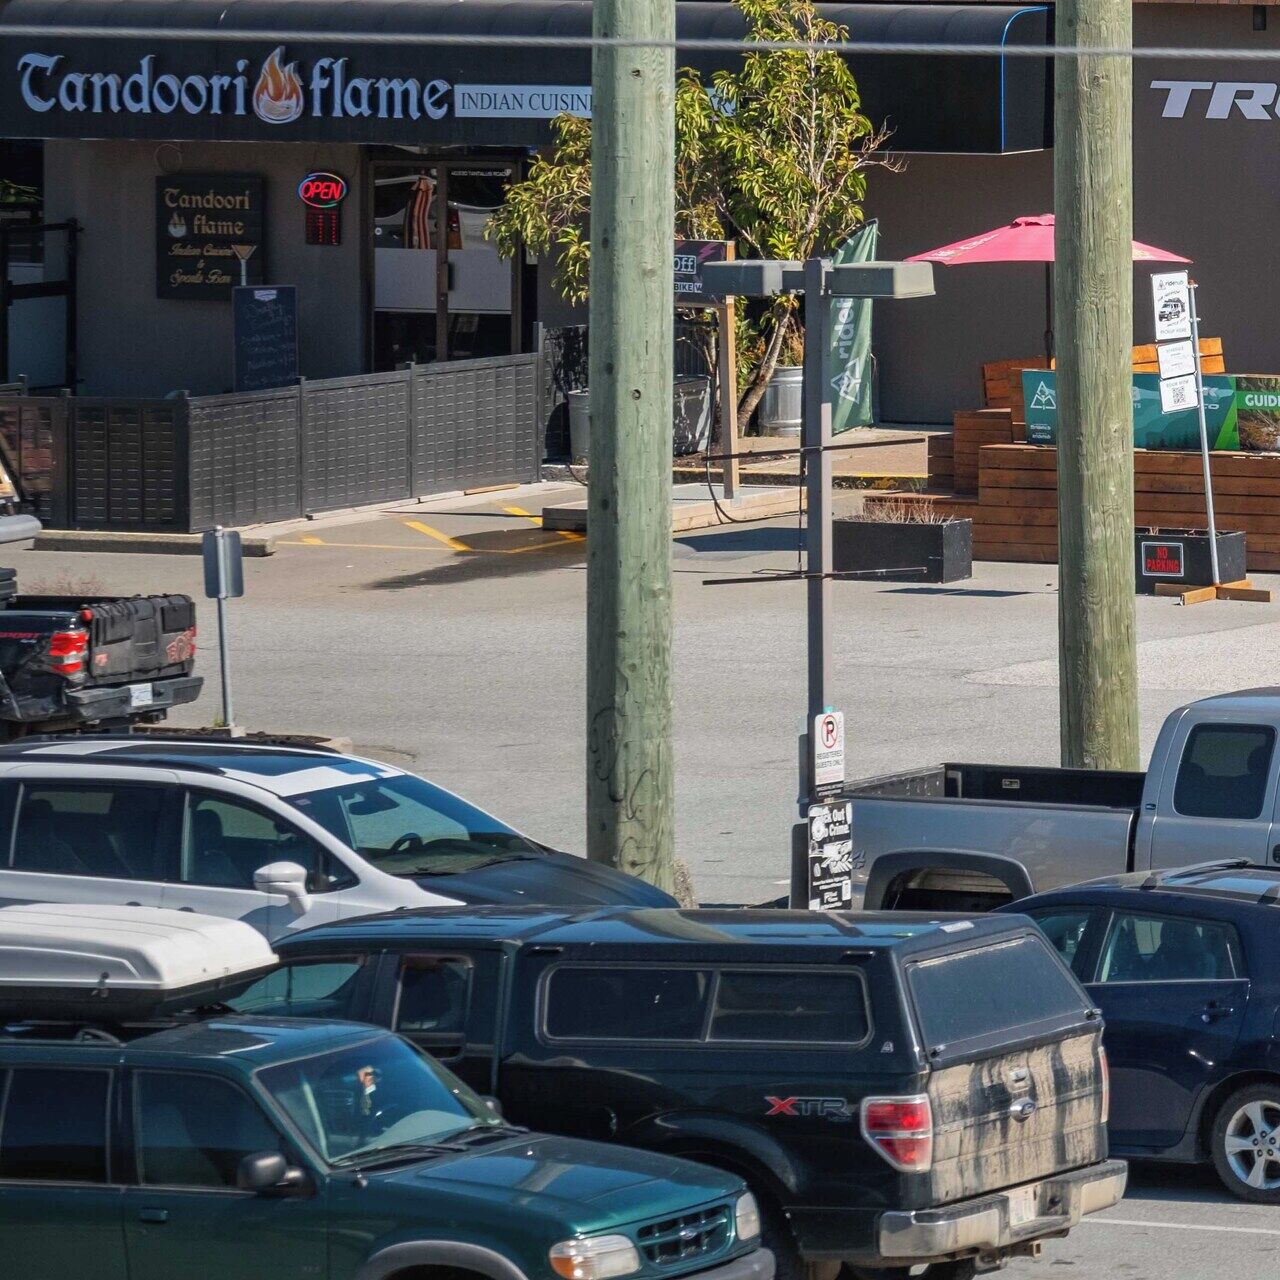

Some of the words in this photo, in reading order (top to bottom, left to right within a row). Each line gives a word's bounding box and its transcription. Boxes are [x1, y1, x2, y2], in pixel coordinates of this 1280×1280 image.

[18, 53, 250, 115] Tandoori
[309, 57, 452, 120] flame
[461, 92, 524, 111] INDIAN
[164, 188, 250, 209] Tandoori
[301, 181, 342, 199] OPEN
[193, 215, 244, 235] flame
[1157, 546, 1168, 559] NO
[1146, 559, 1180, 572] PARKING
[764, 1096, 852, 1117] XTR
